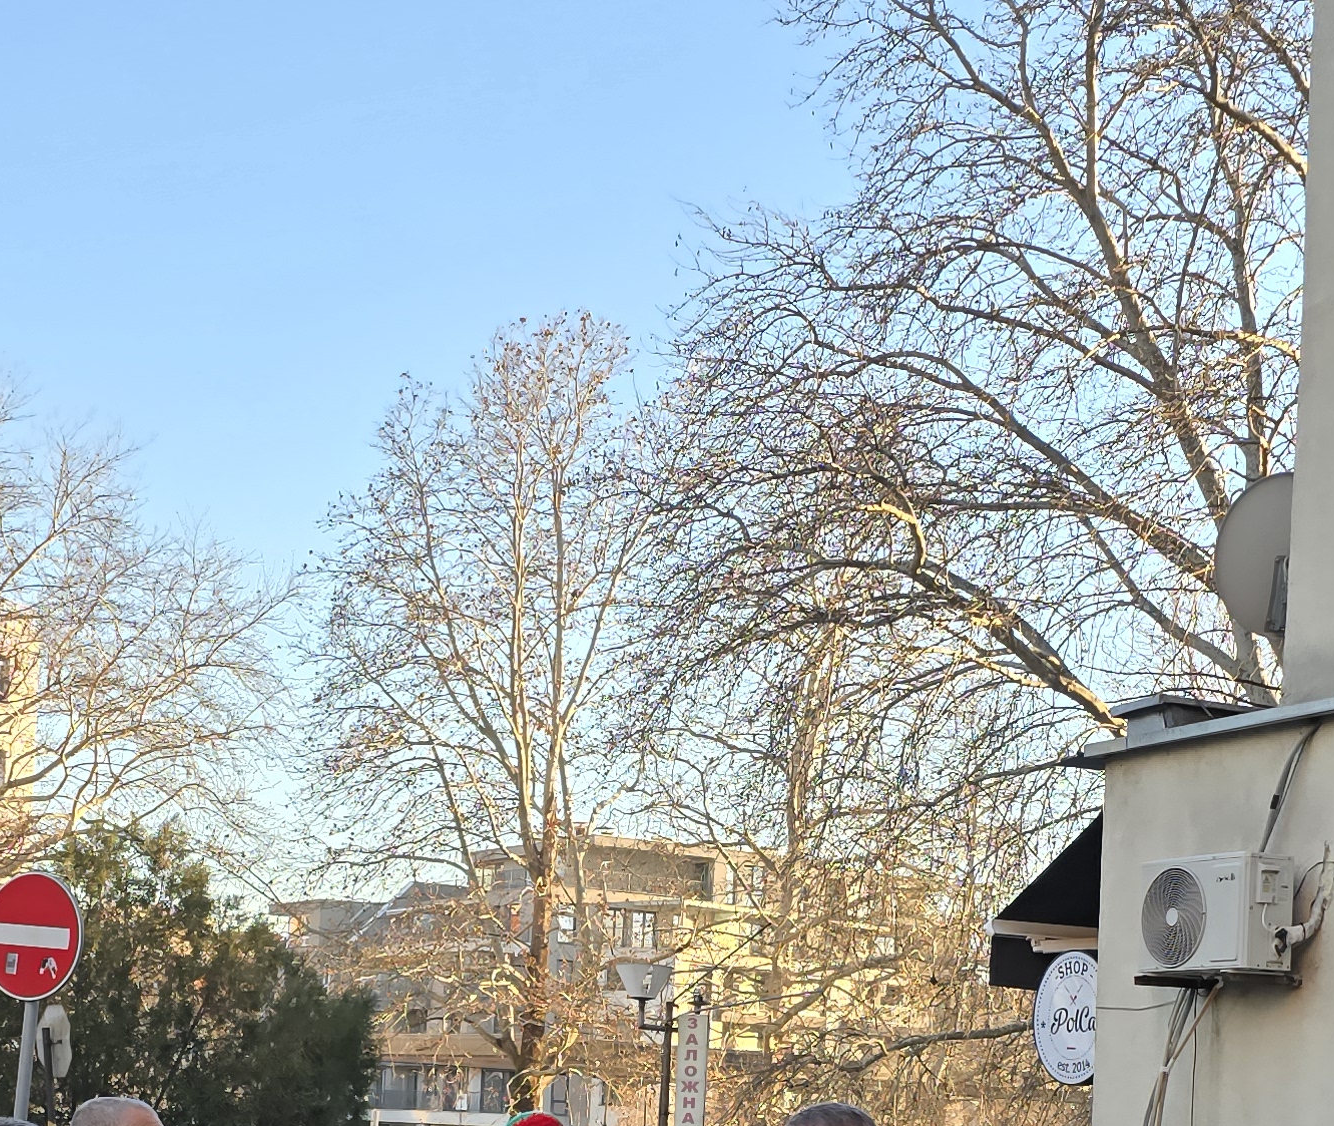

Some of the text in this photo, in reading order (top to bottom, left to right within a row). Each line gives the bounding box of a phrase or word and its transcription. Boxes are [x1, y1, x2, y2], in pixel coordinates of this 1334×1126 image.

[1057, 961, 1089, 980] SHOP
[680, 1017, 700, 1125] ЗАЛОЖНА
[1072, 1059, 1091, 1073] 2014
